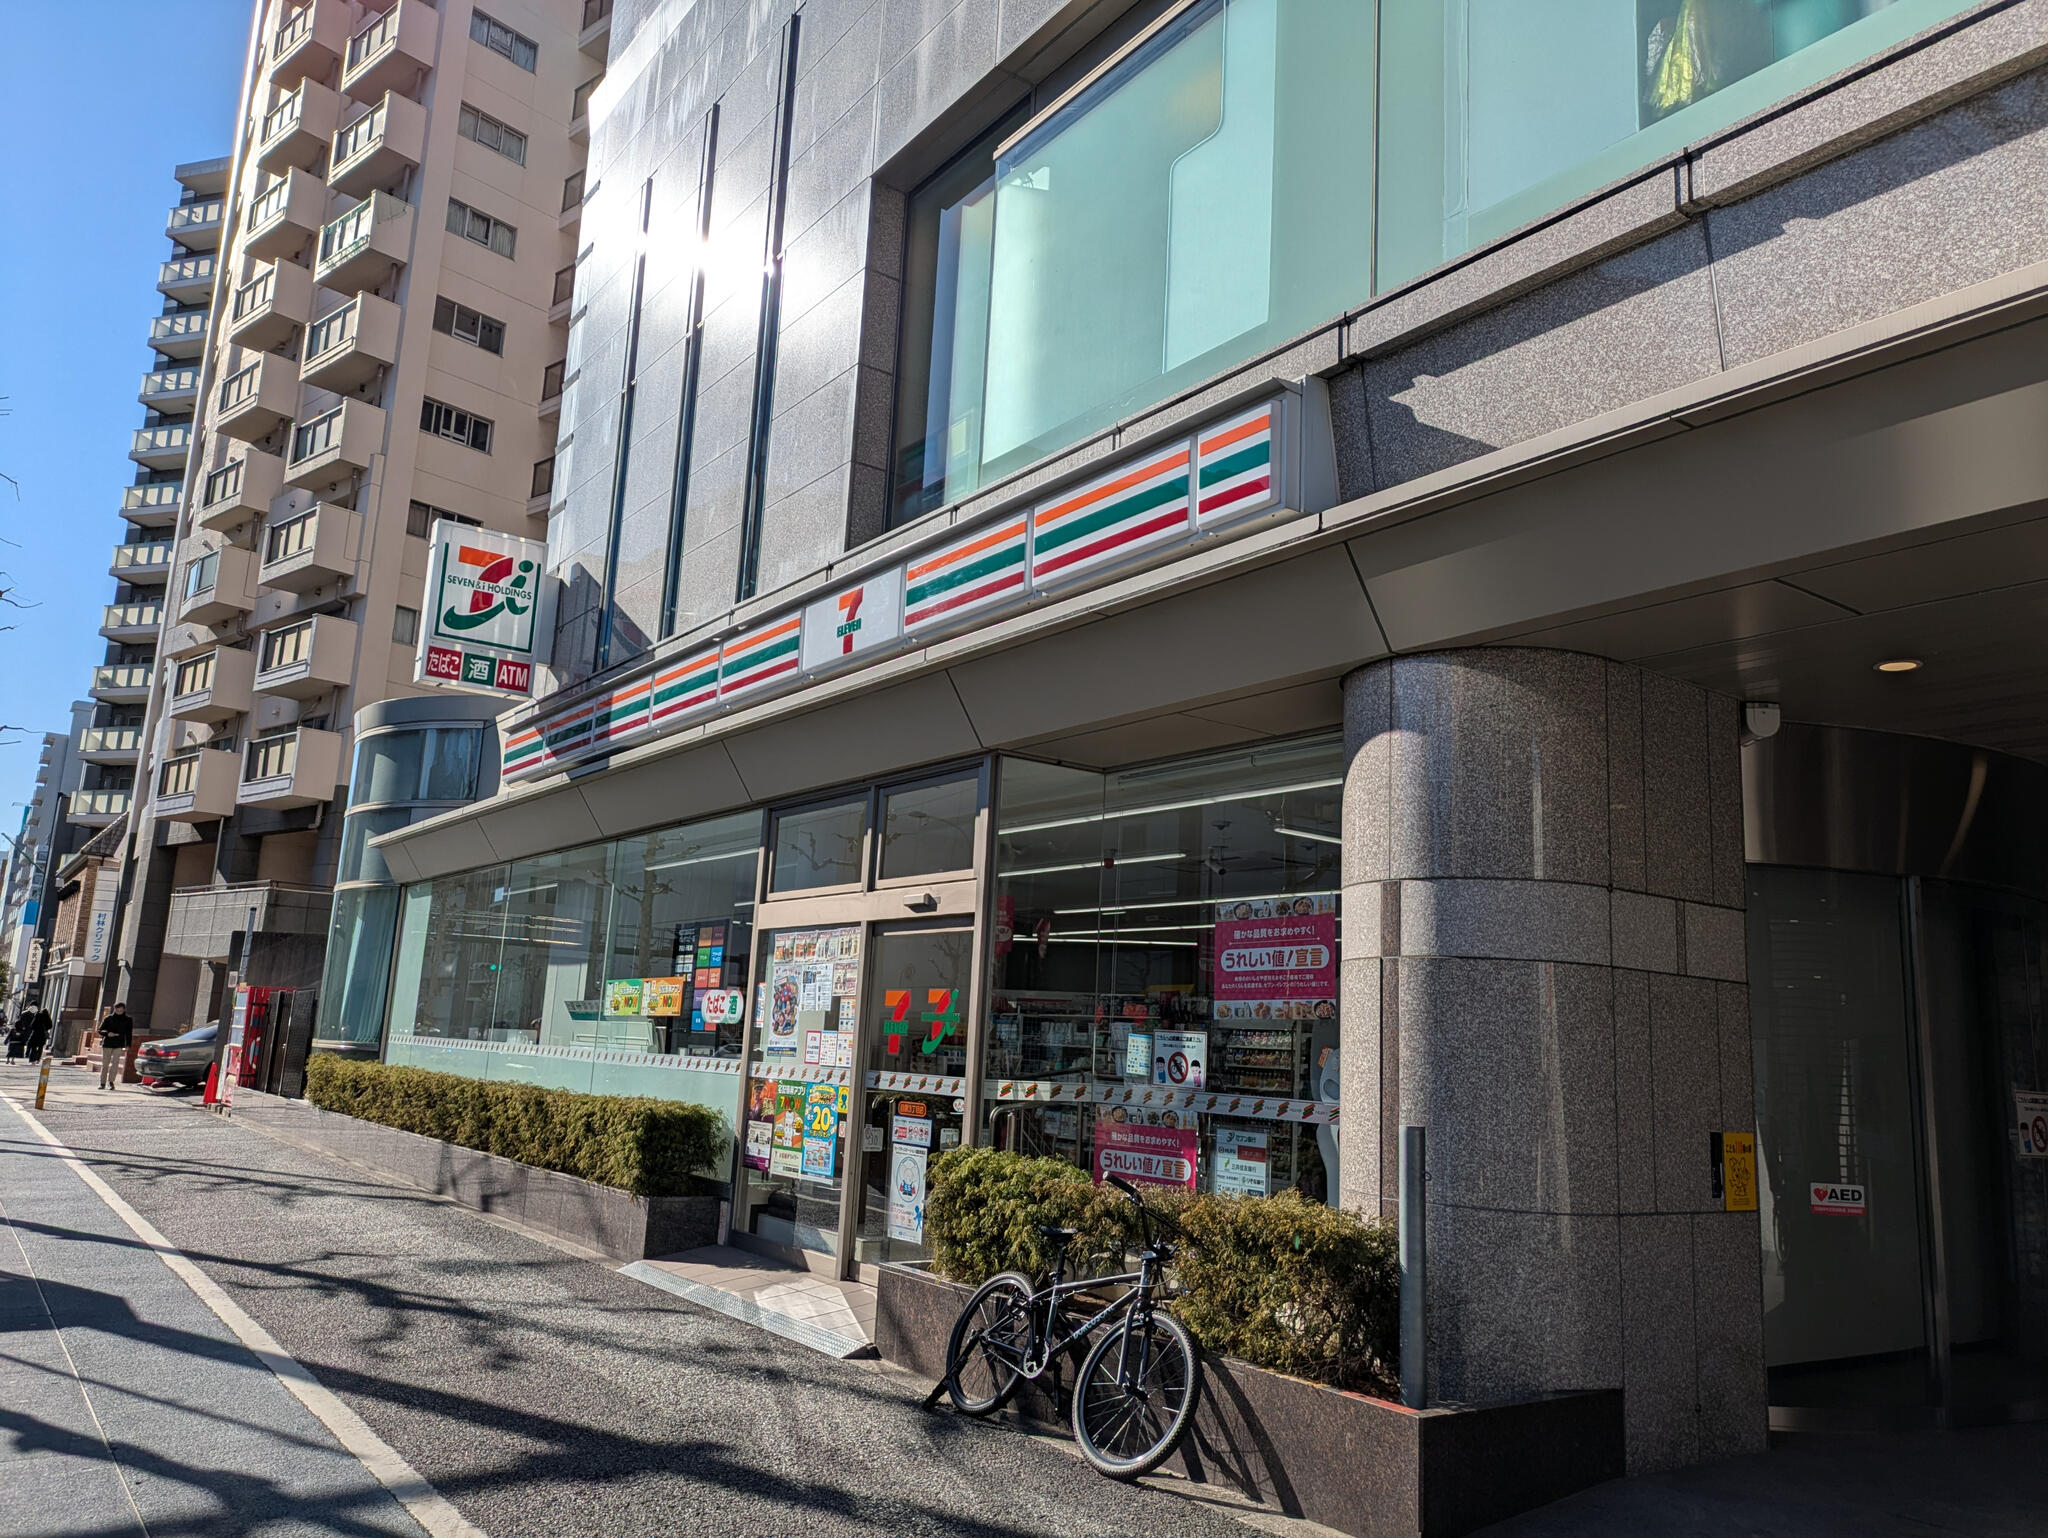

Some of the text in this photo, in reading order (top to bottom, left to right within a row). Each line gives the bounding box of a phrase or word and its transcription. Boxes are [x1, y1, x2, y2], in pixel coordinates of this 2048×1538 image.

[447, 574, 533, 601] SEVEN&i HOLDINGS
[427, 651, 461, 676] たばこ
[468, 658, 491, 680] 酒
[498, 665, 529, 687] ATM
[705, 994, 738, 1015] たばこ 酒
[811, 1105, 832, 1132] 20
[1828, 1188, 1862, 1201] AED
